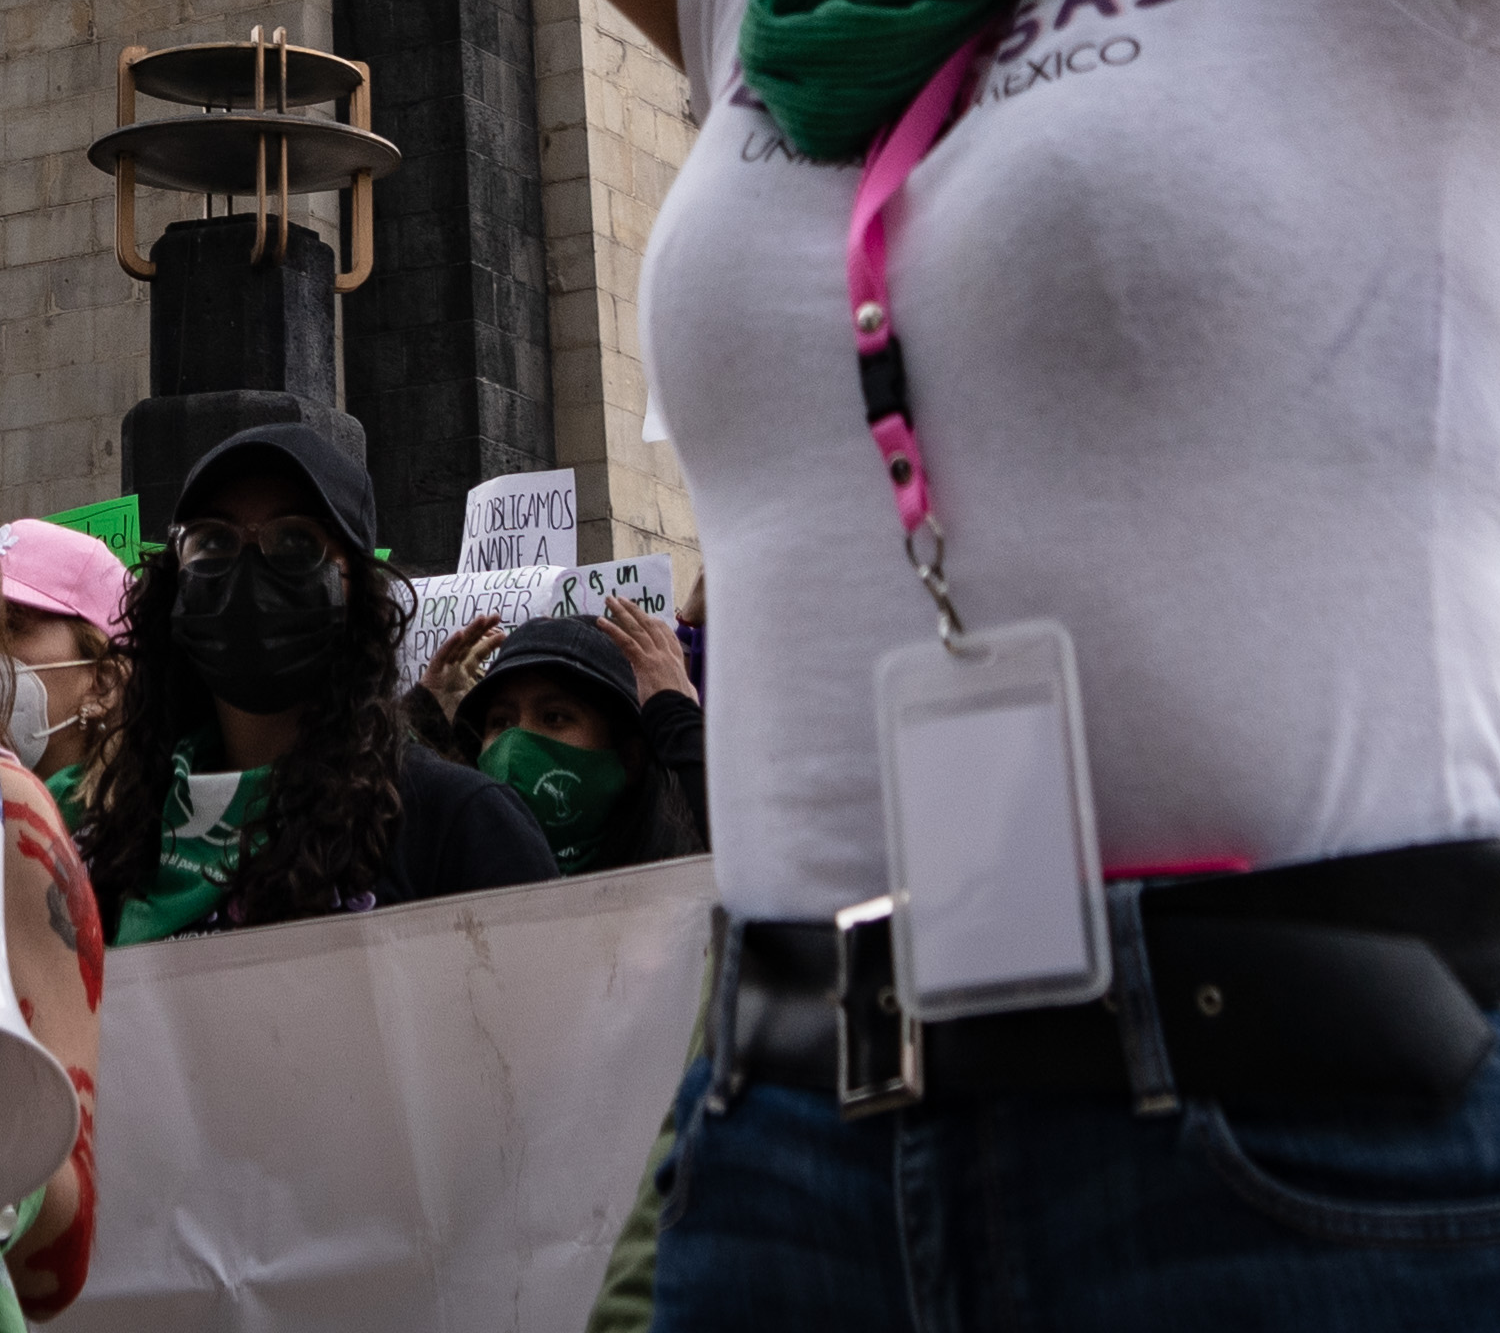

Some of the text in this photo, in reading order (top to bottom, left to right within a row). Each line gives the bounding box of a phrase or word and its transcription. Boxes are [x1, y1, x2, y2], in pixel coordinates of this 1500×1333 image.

[484, 489, 574, 533] OBLIGAMOS
[616, 564, 639, 585] un
[421, 595, 459, 628] POR
